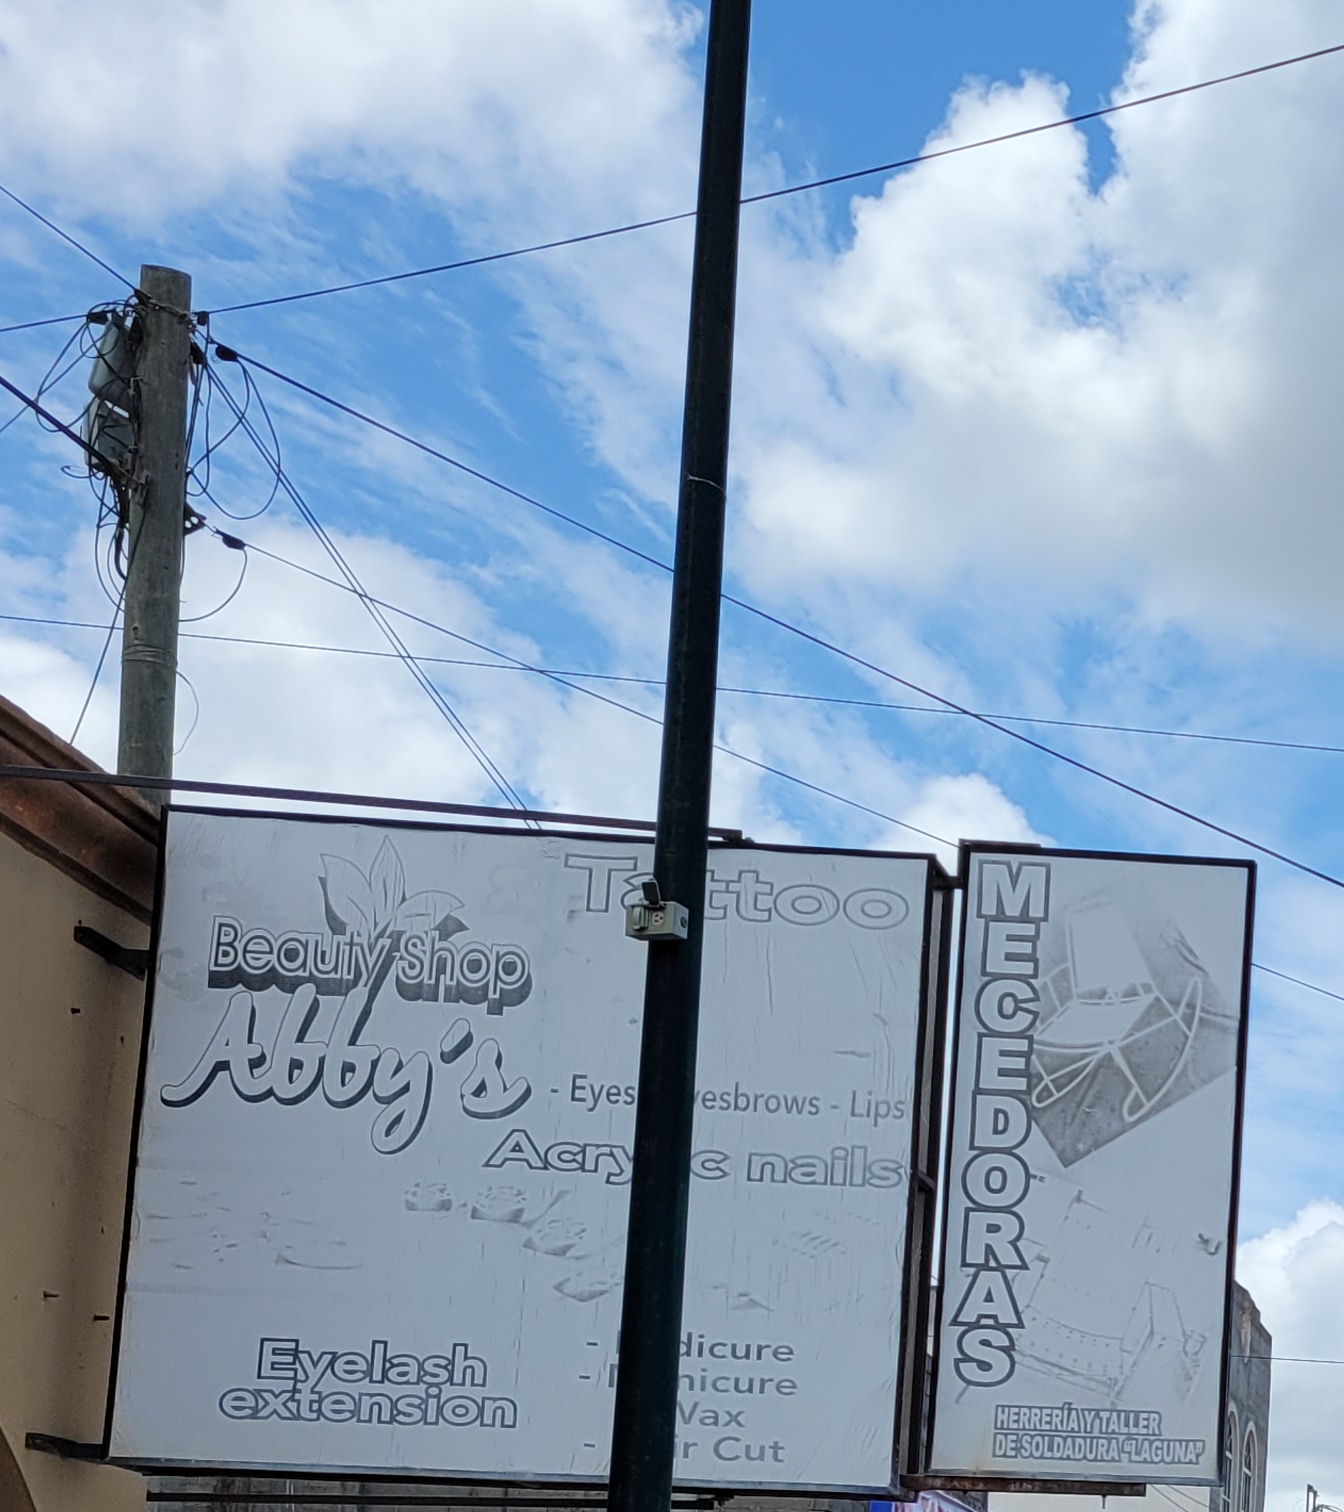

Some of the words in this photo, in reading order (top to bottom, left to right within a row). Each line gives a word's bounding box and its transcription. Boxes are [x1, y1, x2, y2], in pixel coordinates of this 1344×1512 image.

[208, 914, 396, 993] Beauty
[396, 930, 532, 1014] Shop
[160, 982, 532, 1155] Abby's
[570, 1073, 636, 1112] Eyes
[693, 1082, 820, 1116] esbrows
[851, 1089, 906, 1127] Lips
[950, 860, 1050, 1387] MECEDORAS
[483, 1128, 731, 1186] Acryc
[747, 1145, 906, 1188] nails
[256, 1337, 488, 1390] Eyelash
[616, 1330, 795, 1362] dicure
[608, 1363, 798, 1396] nicure
[218, 1385, 518, 1429] extension
[994, 1402, 1080, 1432] HERRERÍA
[1081, 1408, 1099, 1434] Y
[1099, 1409, 1162, 1436] TALLER
[712, 1436, 786, 1463] Cut
[993, 1432, 1018, 1458] DE
[1018, 1433, 1122, 1462] SOLDADURA
